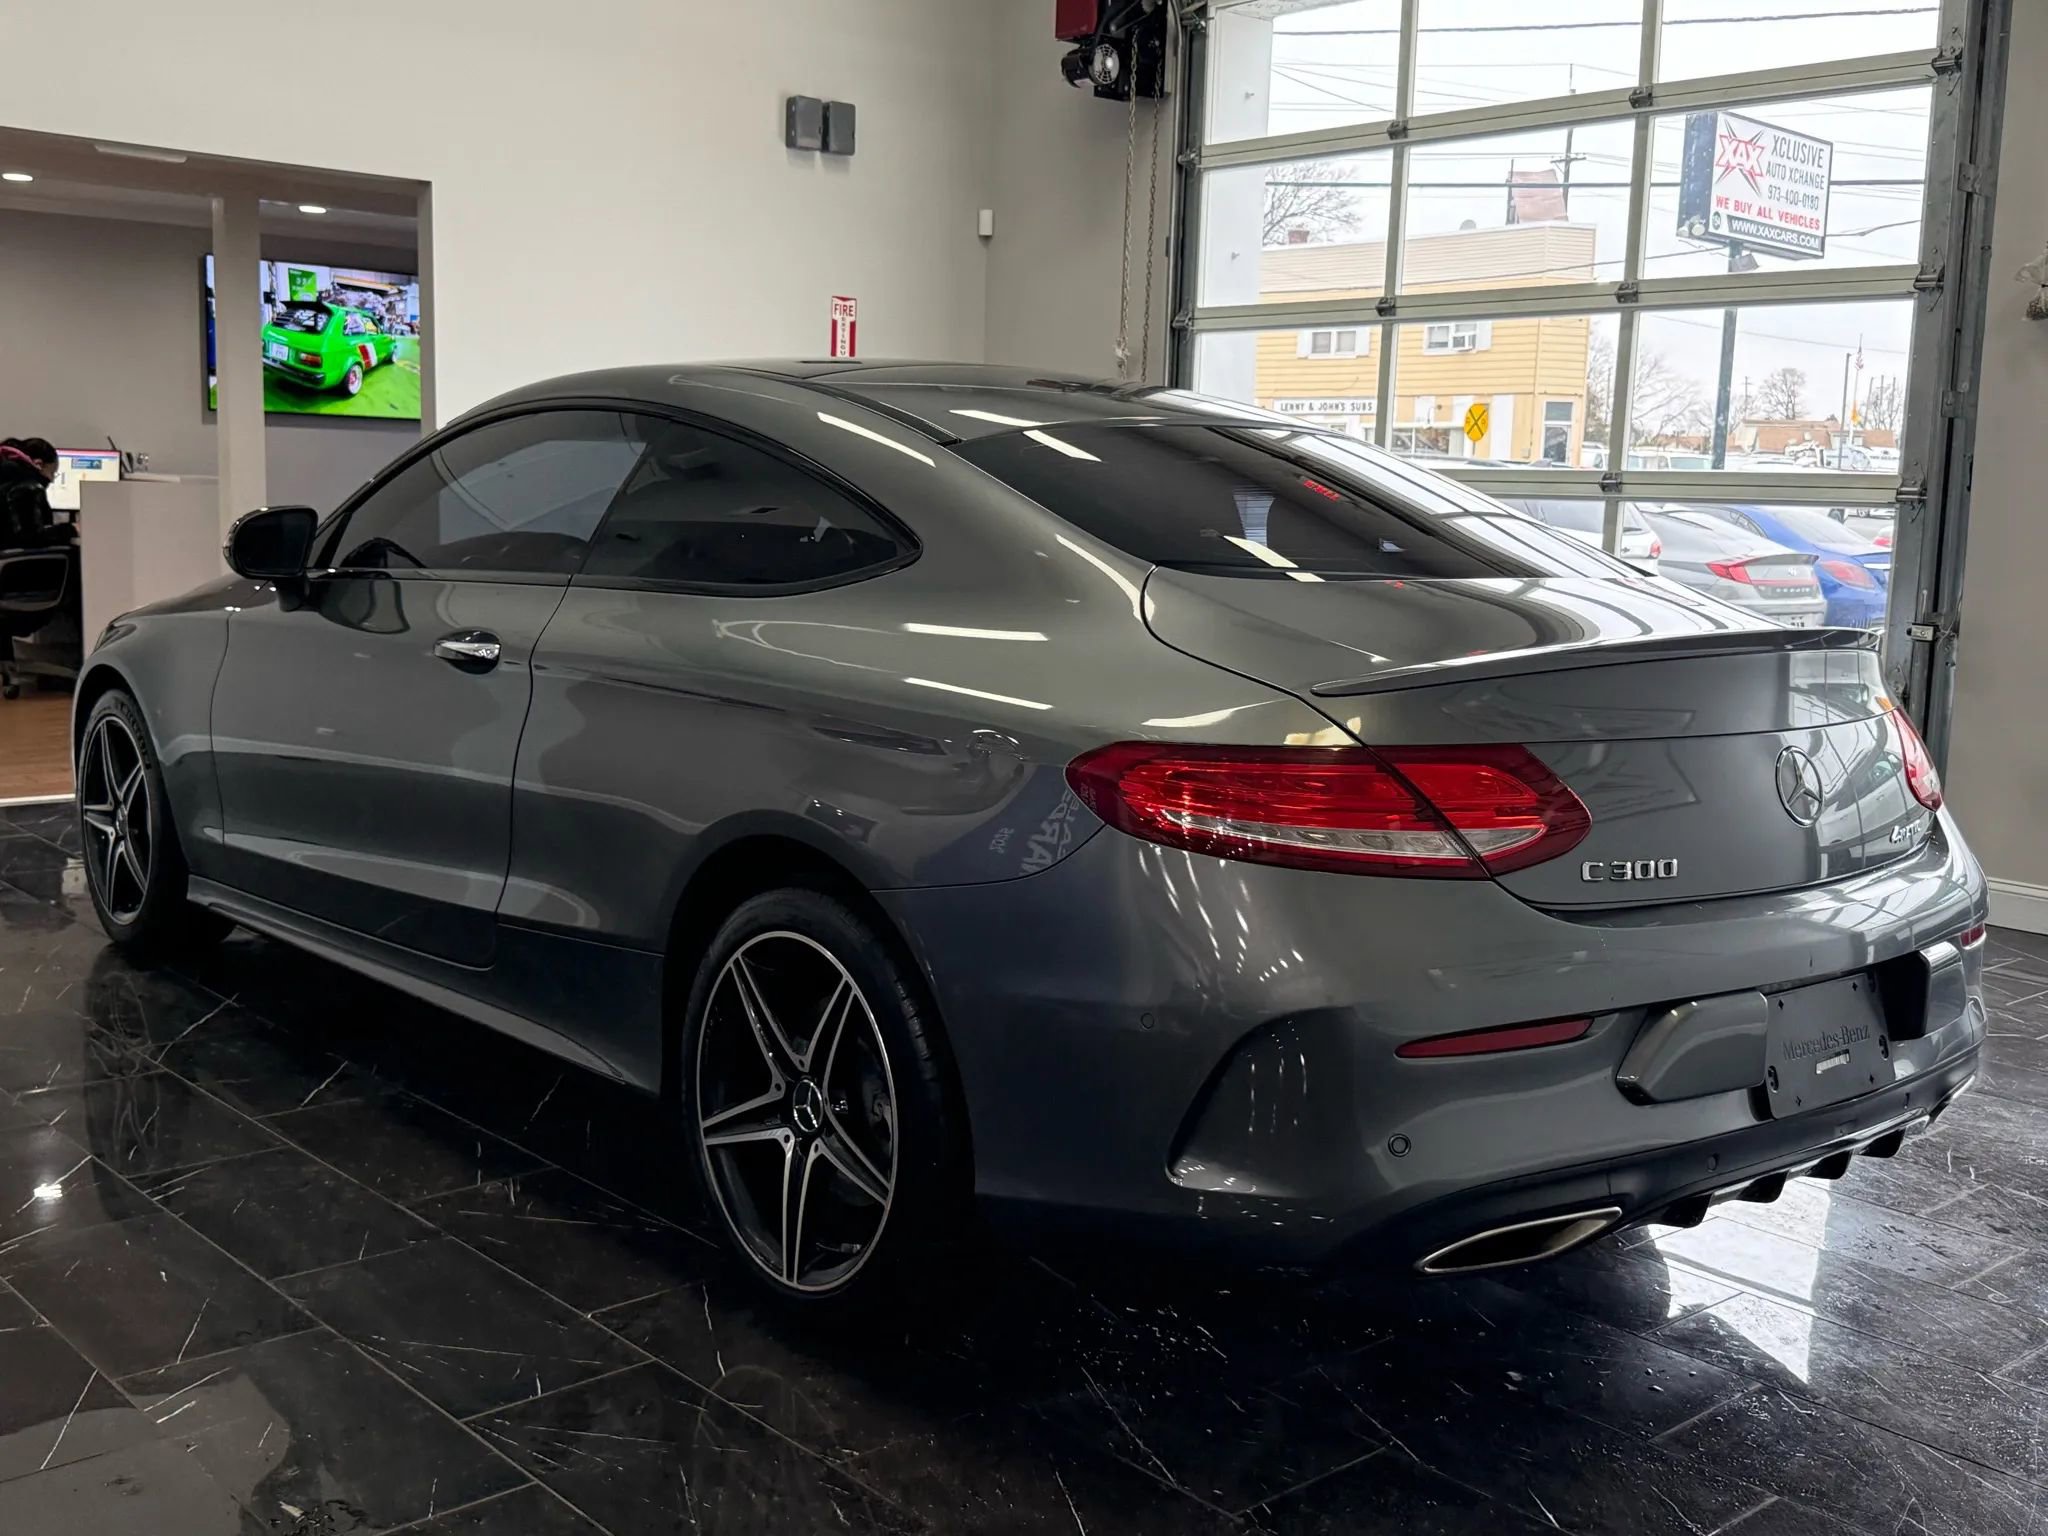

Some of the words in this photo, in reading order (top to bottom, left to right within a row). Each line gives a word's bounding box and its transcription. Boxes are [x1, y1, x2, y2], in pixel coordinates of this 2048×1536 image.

[1715, 134, 1766, 177] XAX
[1771, 134, 1825, 168] XCLUSIVE
[1766, 161, 1786, 180] AUTO
[1788, 166, 1825, 190] XCHANGE
[1716, 195, 1729, 209] WE
[1734, 199, 1752, 215] BUY
[1756, 205, 1774, 220] ALL
[1778, 210, 1820, 231] VEHICLES
[1731, 219, 1819, 247] WWW.XAXCARS.COM
[834, 303, 854, 317] FIRE
[1308, 402, 1314, 411] &
[1351, 402, 1373, 411] SUBS
[1581, 861, 1604, 881] C
[1609, 858, 1678, 881] 300
[1782, 1023, 1871, 1061] Mercedes-Benz
